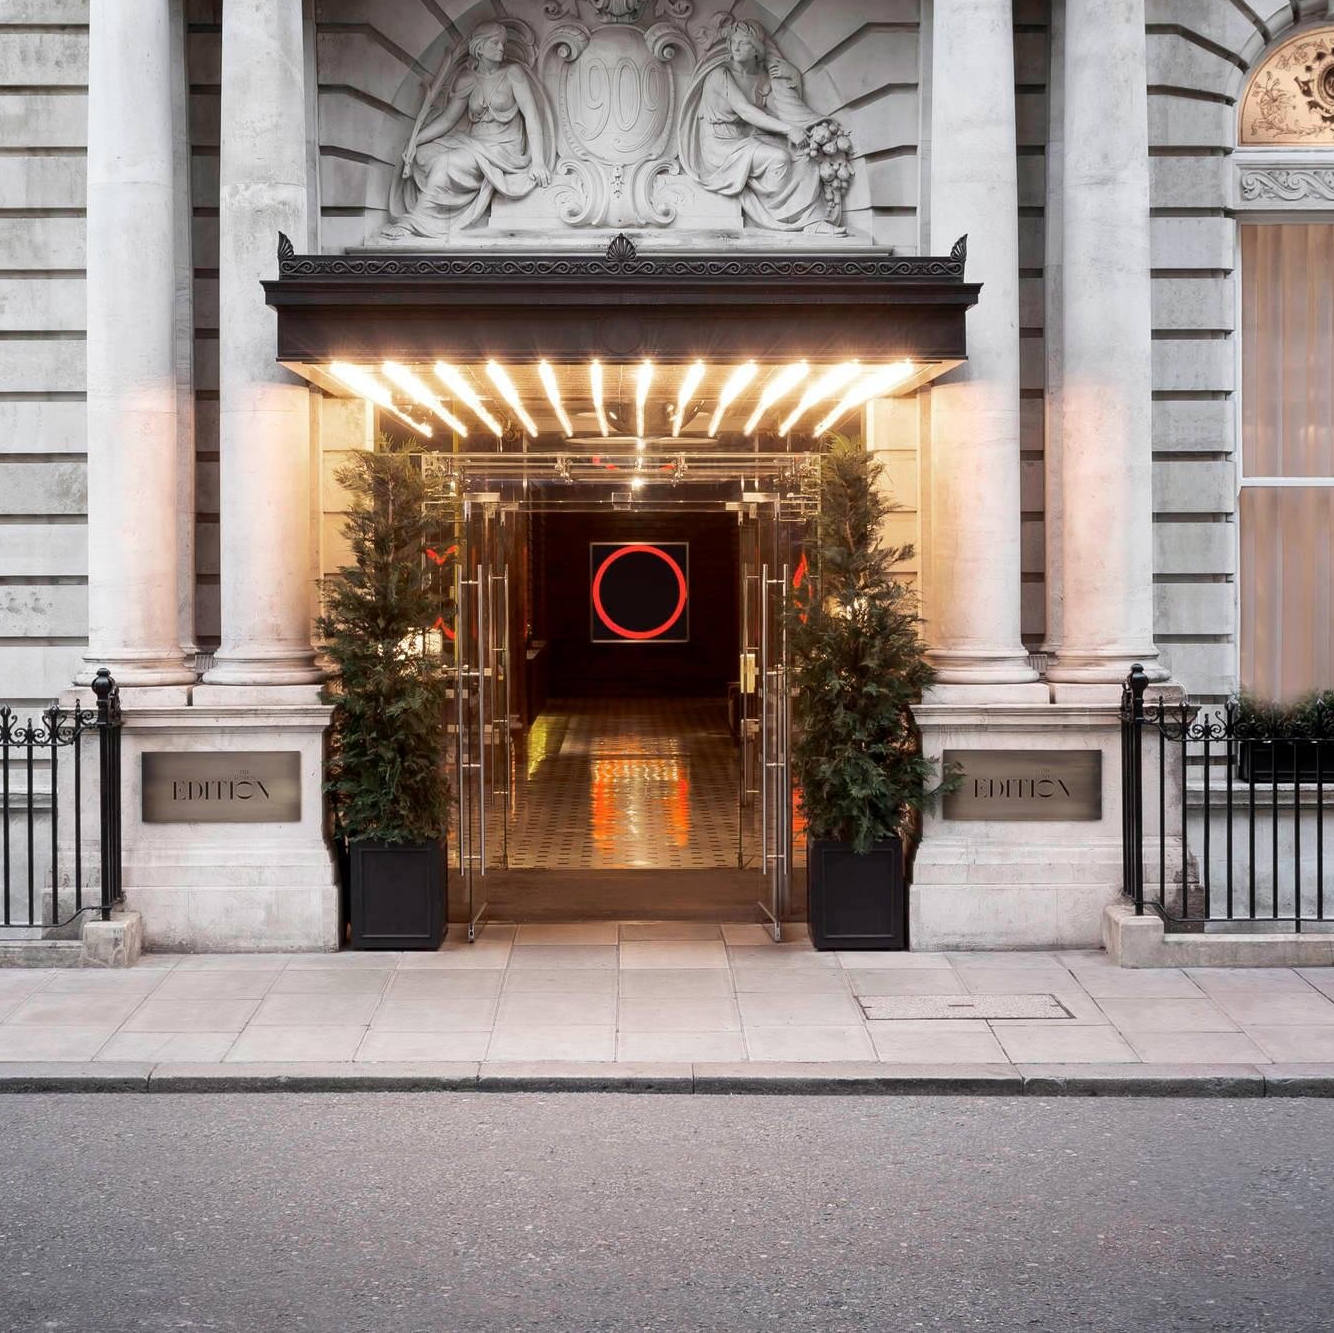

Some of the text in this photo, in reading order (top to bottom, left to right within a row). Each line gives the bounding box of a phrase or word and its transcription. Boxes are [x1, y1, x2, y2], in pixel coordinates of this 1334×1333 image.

[573, 58, 663, 154] 1909
[173, 780, 269, 800] EDITION
[975, 778, 1070, 798] EDITION
